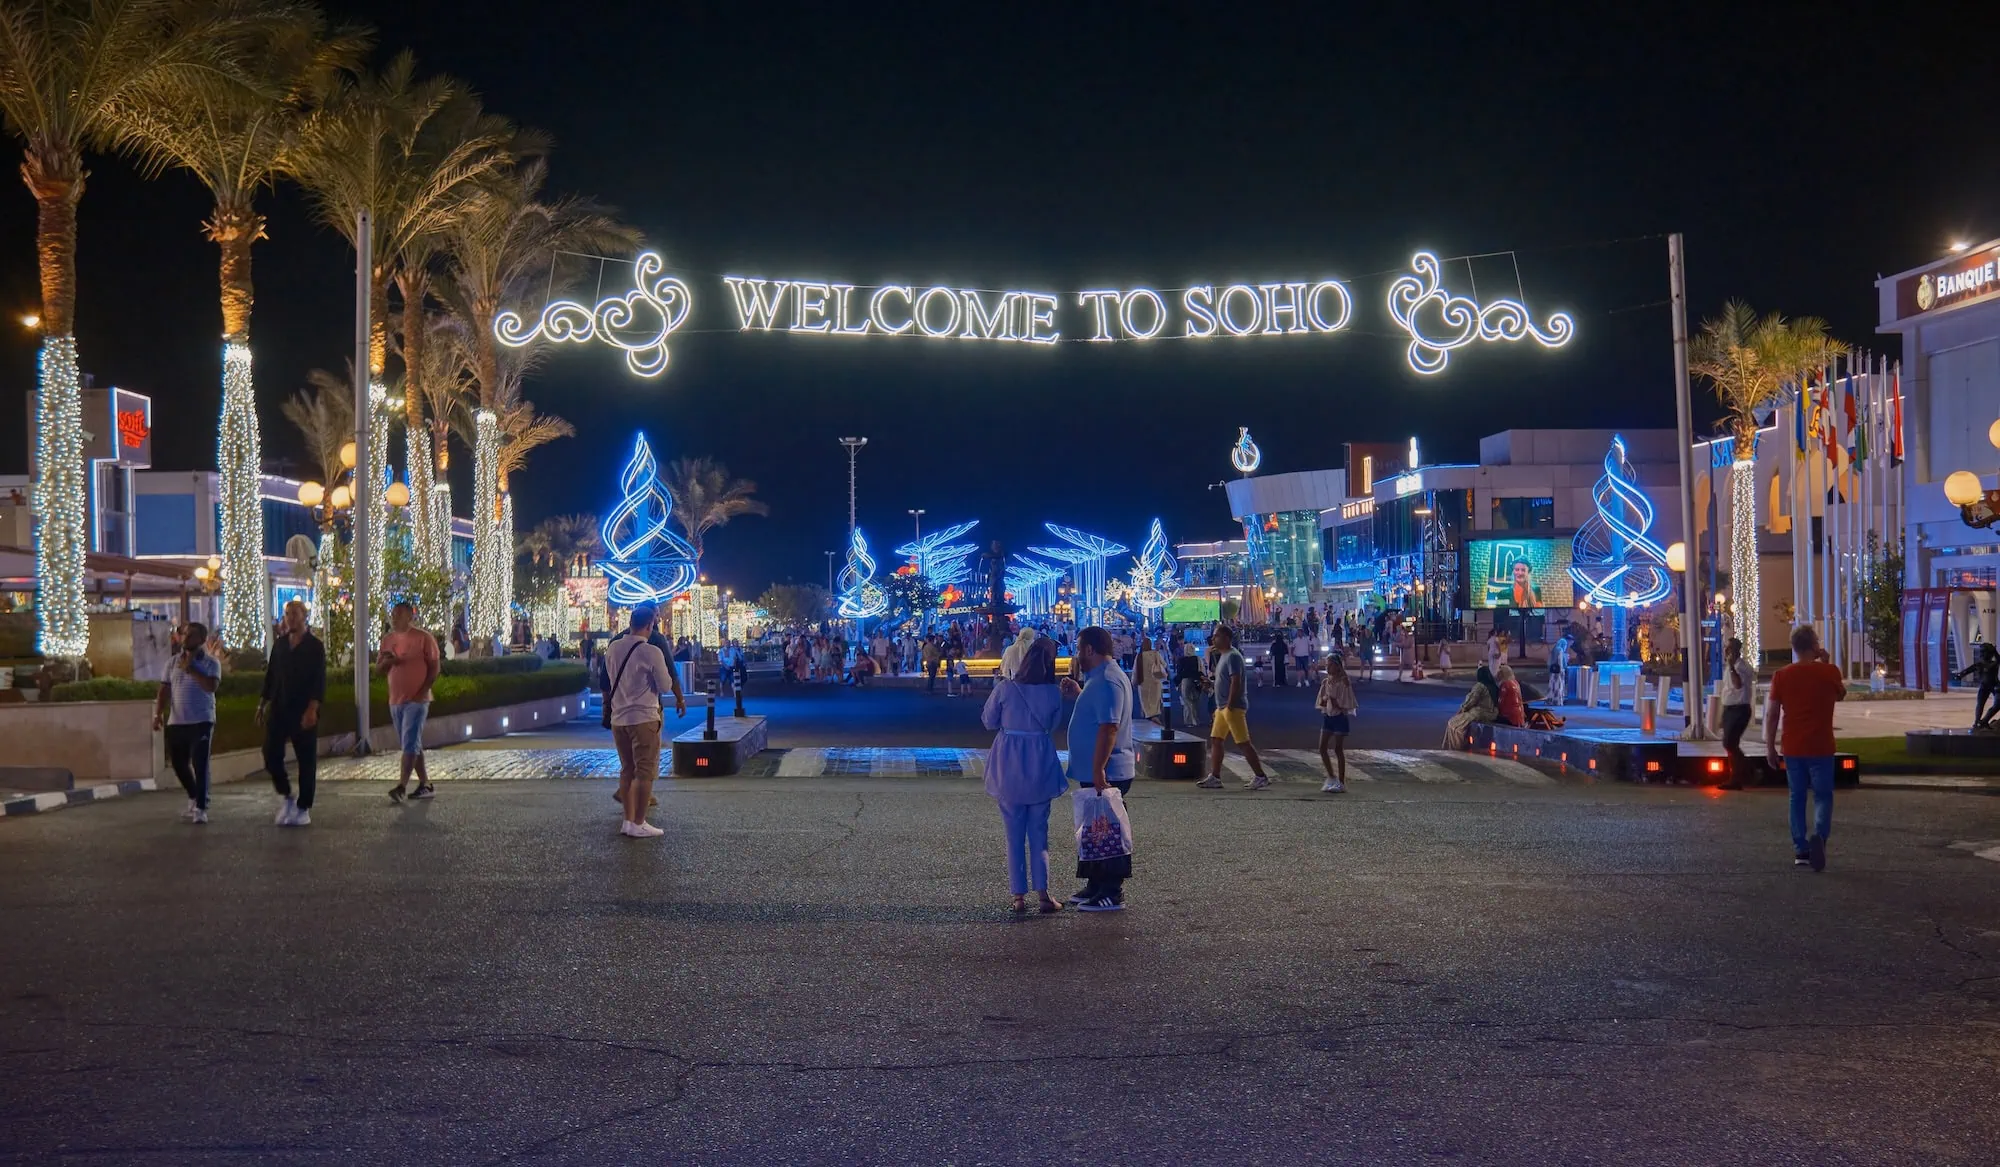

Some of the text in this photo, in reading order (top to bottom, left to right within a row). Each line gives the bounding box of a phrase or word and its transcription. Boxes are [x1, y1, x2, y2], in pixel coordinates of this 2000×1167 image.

[1937, 262, 1994, 298] BANQUE
[723, 276, 1352, 344] WELCOME TO SOHO
